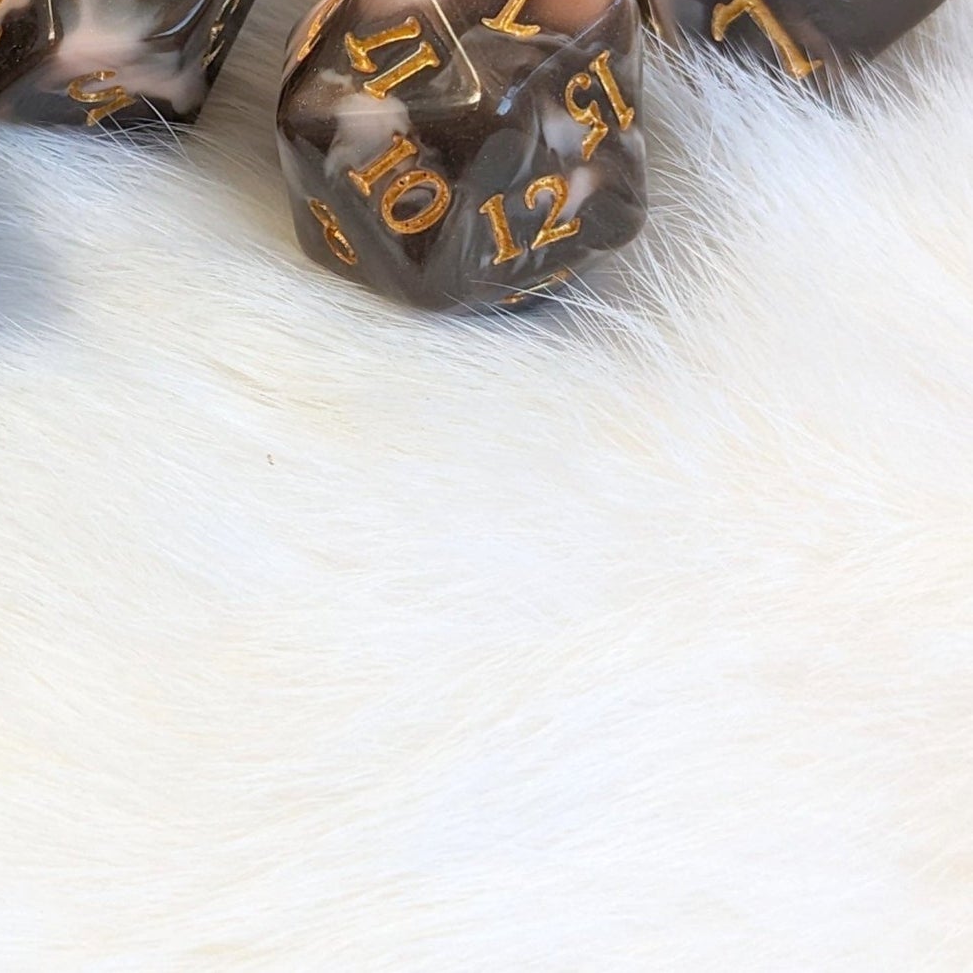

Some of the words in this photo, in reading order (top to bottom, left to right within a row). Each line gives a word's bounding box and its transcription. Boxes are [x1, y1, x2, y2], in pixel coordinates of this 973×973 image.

[564, 49, 635, 162] 15
[348, 134, 452, 235] 10
[478, 174, 581, 266] 12
